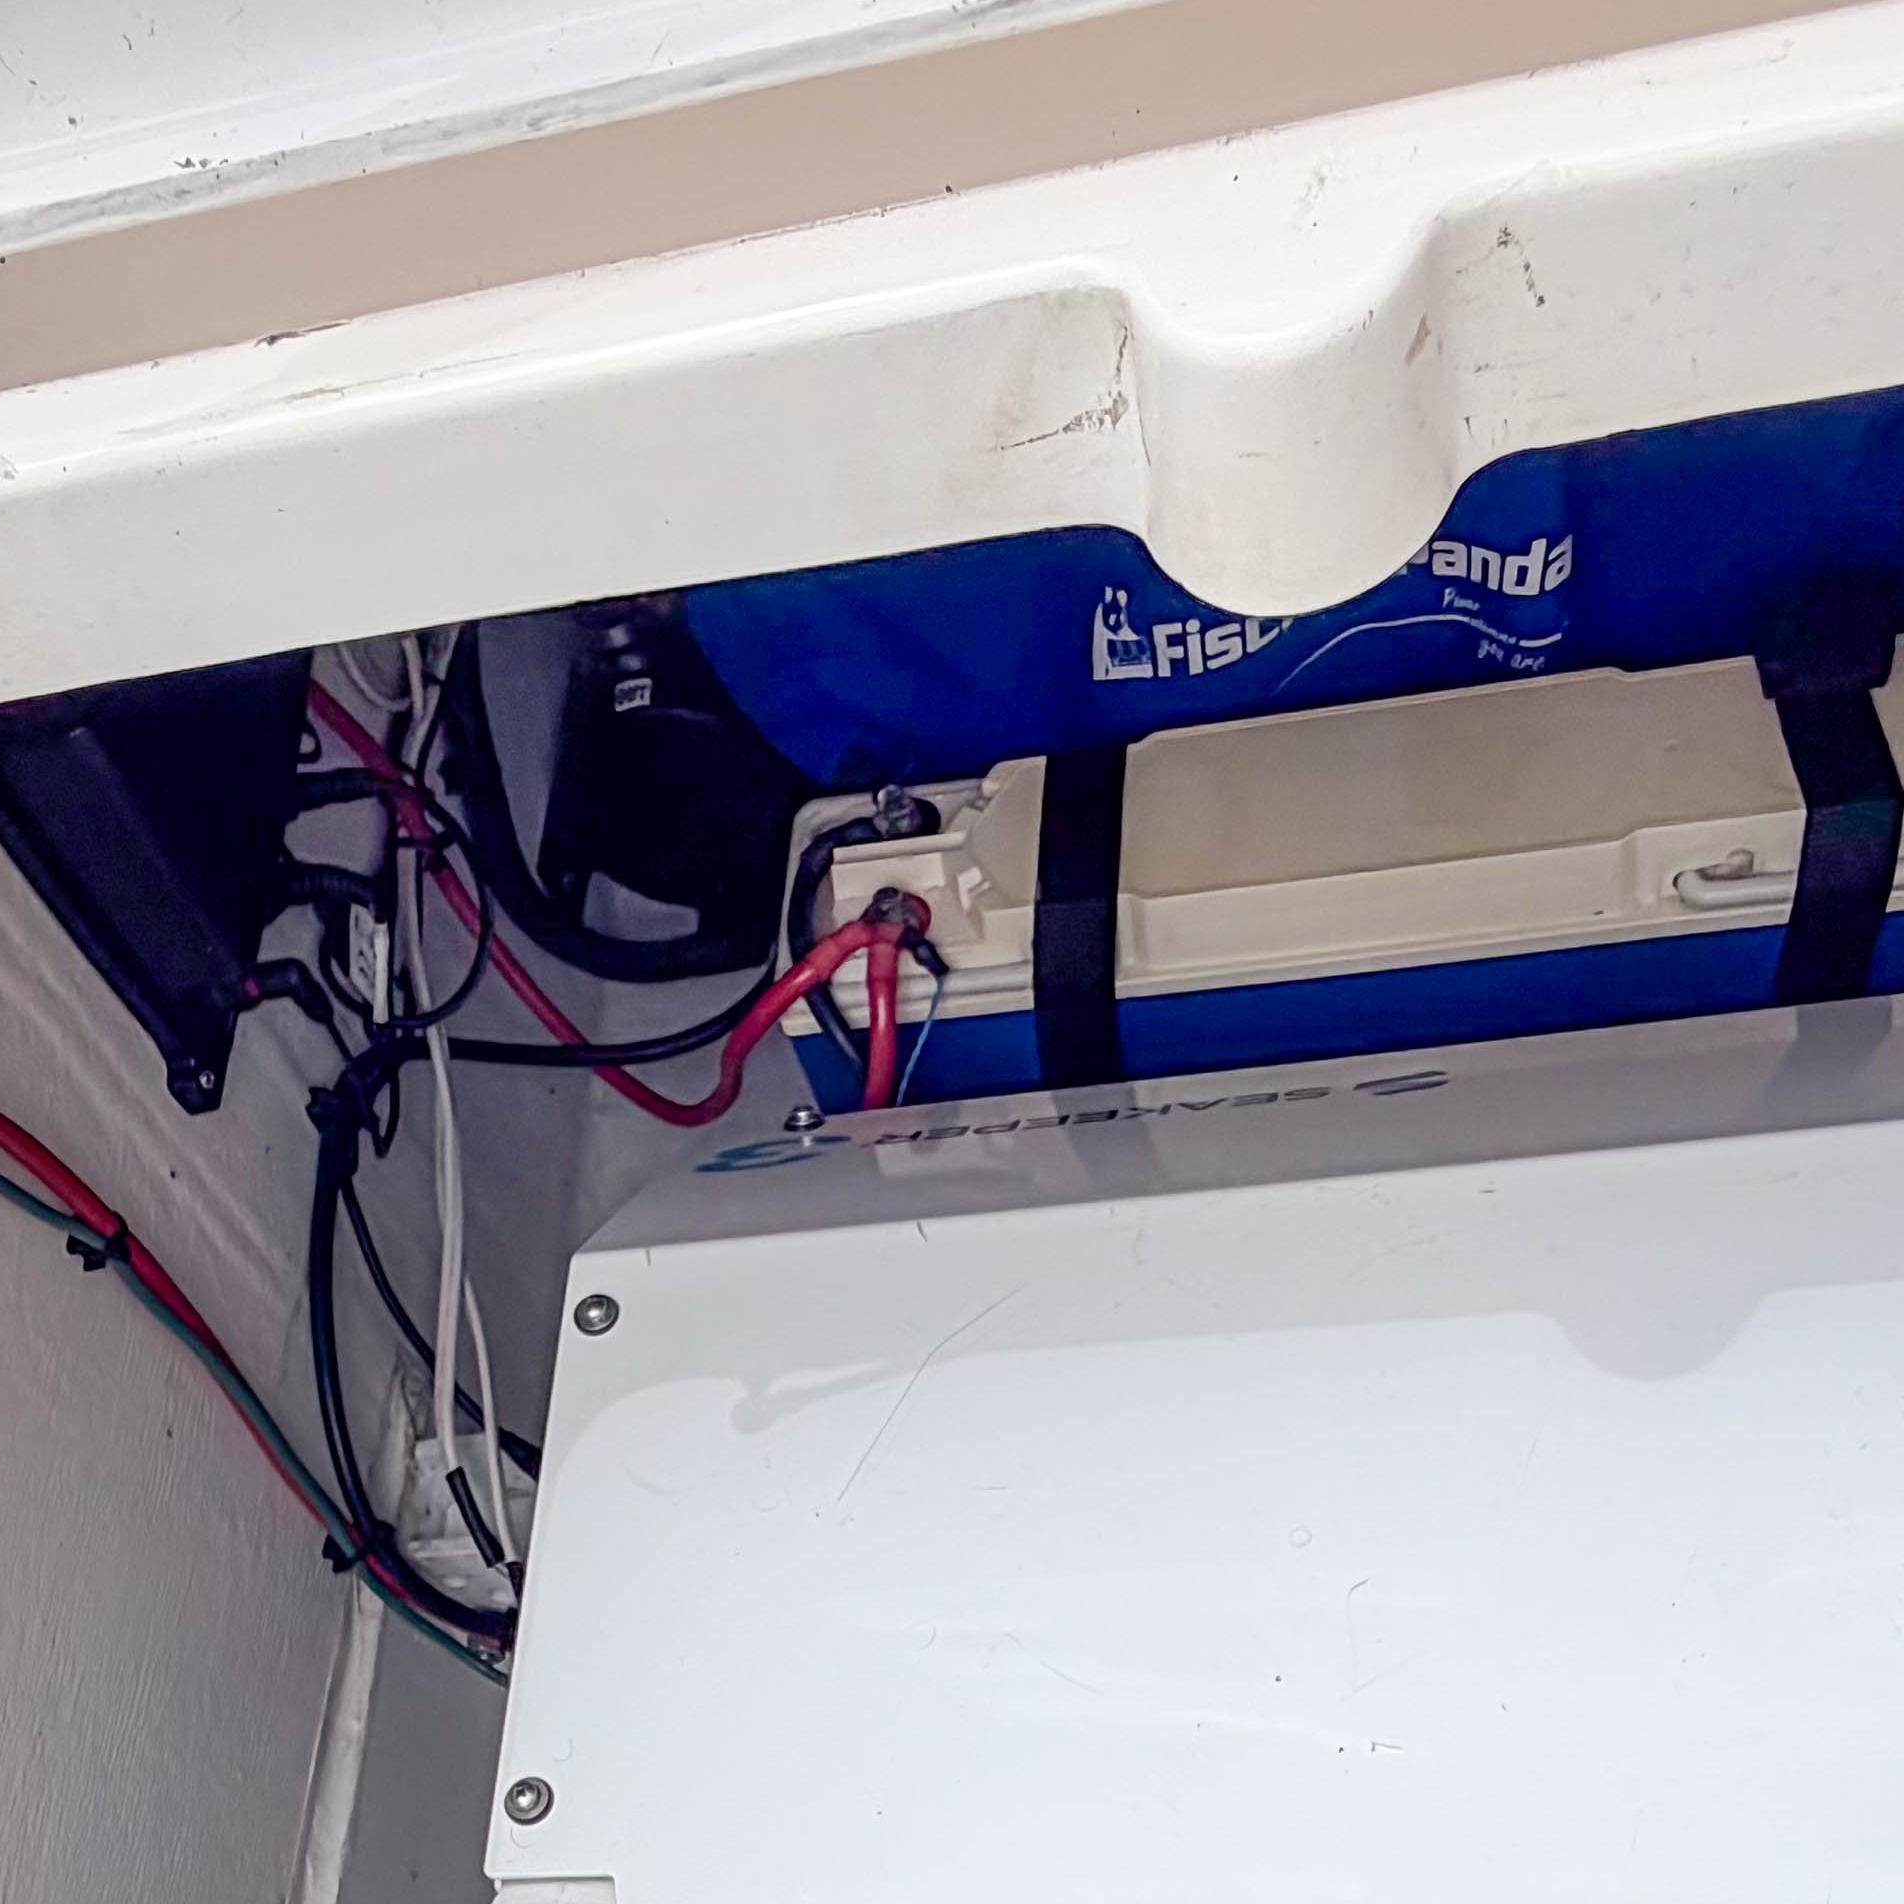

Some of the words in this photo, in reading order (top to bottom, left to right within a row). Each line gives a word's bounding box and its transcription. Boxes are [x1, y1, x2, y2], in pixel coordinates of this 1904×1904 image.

[1153, 618, 1295, 677] Fisc
[1398, 533, 1573, 596] anda
[872, 1086, 1333, 1146] SEAKEEPER
